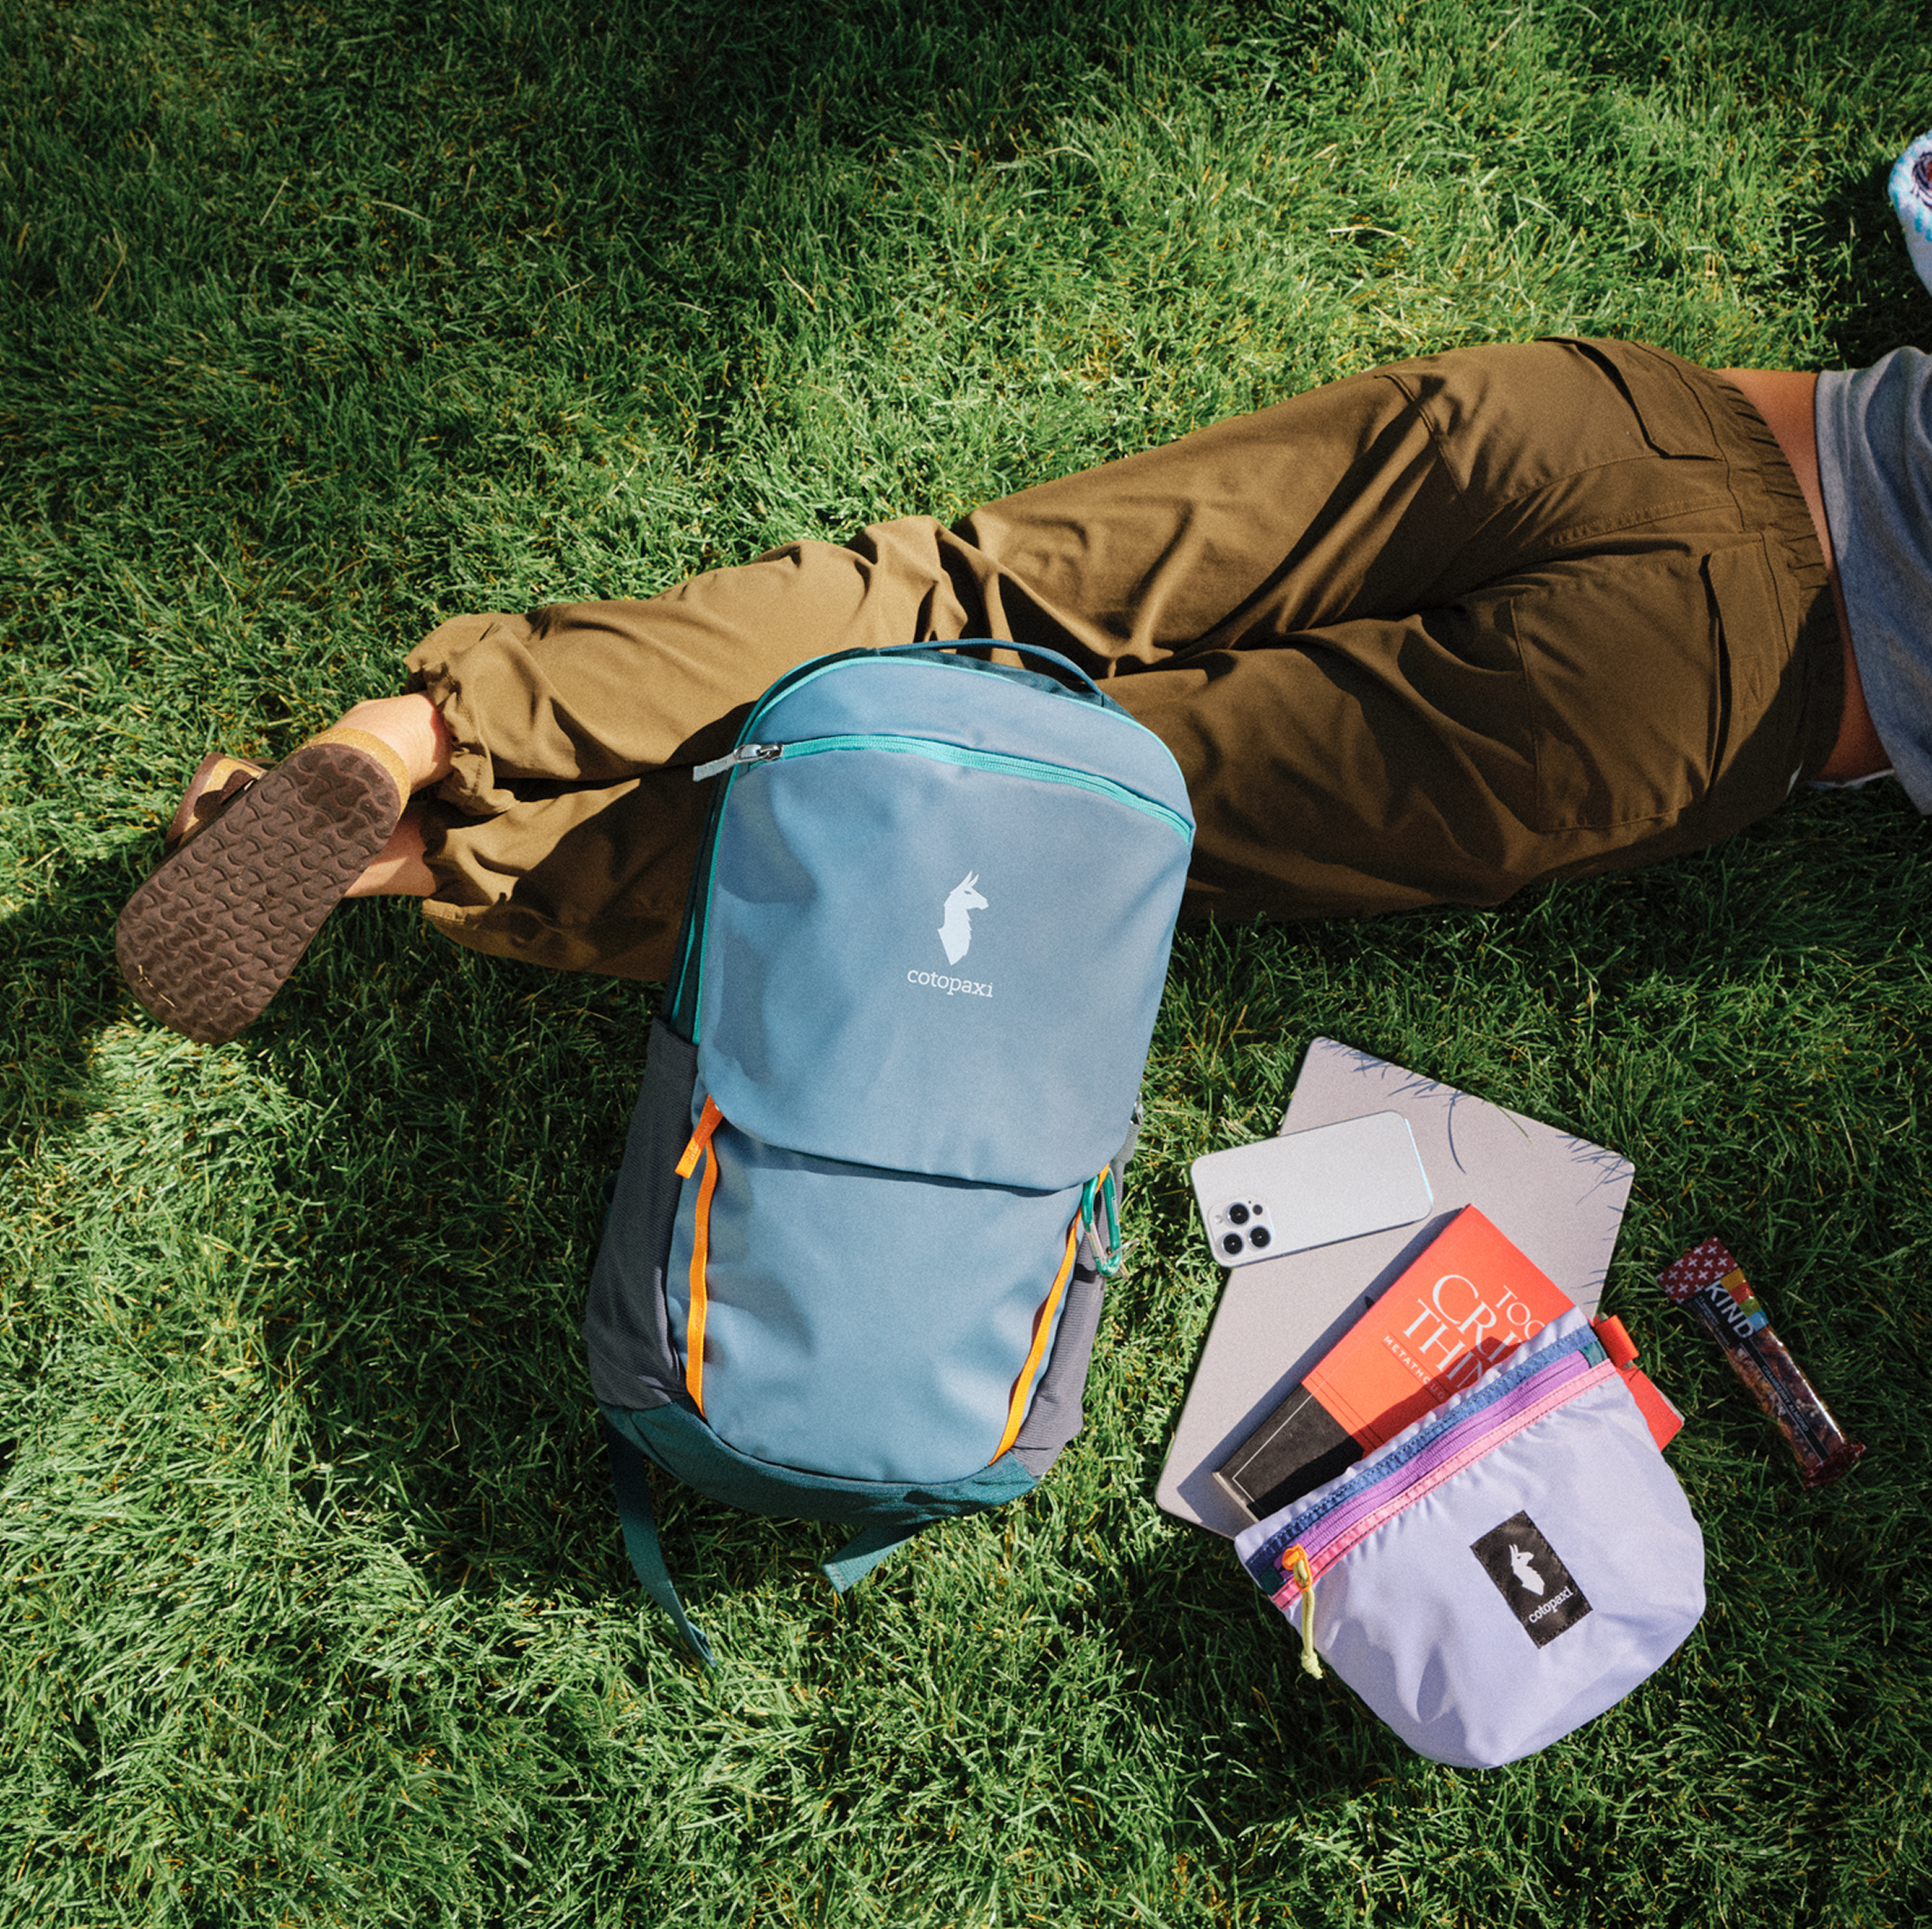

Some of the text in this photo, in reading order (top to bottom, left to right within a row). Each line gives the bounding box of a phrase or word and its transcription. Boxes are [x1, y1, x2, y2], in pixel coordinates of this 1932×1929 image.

[907, 970, 993, 997] cotopaxi
[1432, 1274, 1523, 1363] CRI
[1704, 1280, 1754, 1339] KIND
[1787, 1404, 1810, 1432] ALMOND
[1528, 1585, 1574, 1624] cotopaxi
